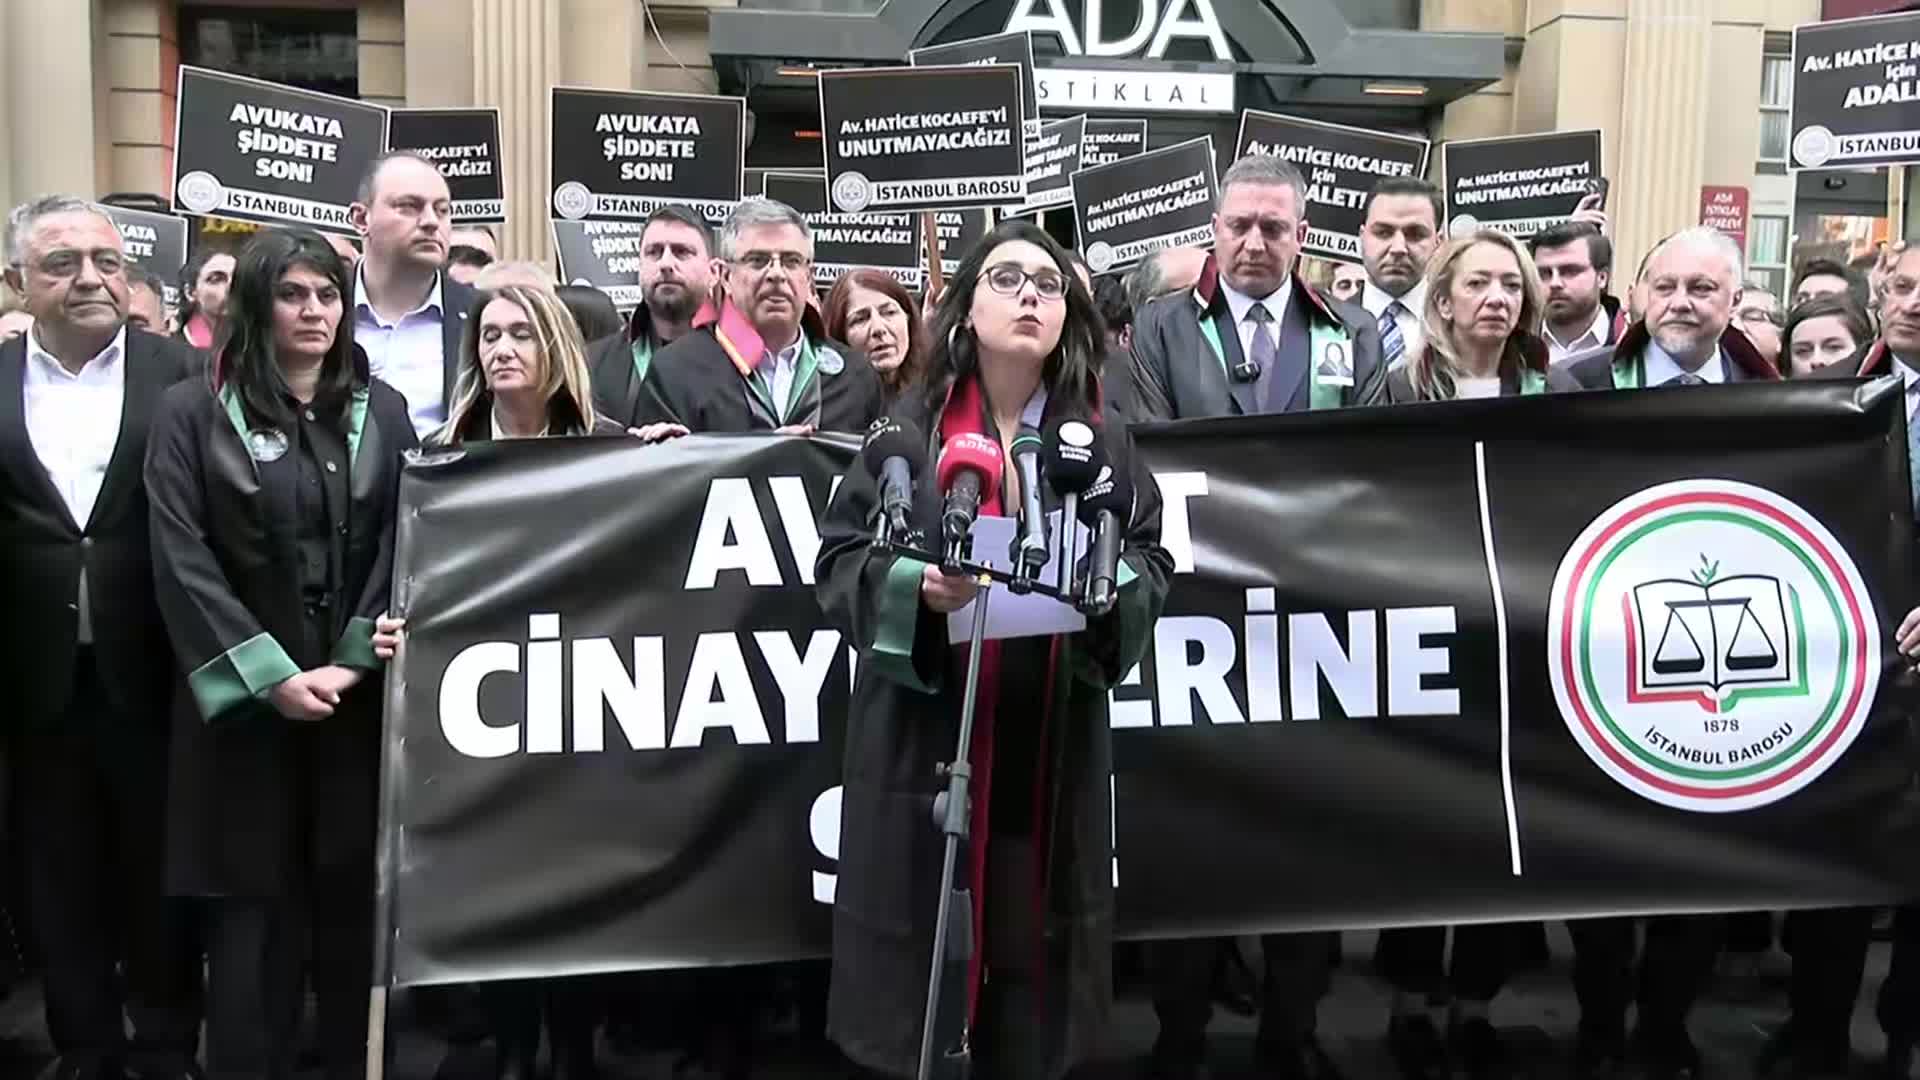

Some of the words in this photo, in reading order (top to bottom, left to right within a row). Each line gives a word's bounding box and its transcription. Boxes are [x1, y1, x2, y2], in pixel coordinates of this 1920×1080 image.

[1001, 0, 1237, 61] ADA
[1801, 55, 1832, 73] Av.
[1834, 42, 1909, 69] HATİCE
[1885, 62, 1917, 82] için
[1038, 76, 1209, 105] STİKLAL
[1842, 80, 1920, 109] ADAL
[229, 102, 344, 139] AVUKATA
[595, 113, 701, 135] AVUKATA
[840, 119, 863, 135] Av.
[864, 113, 919, 132] HATİCE
[921, 106, 1008, 128] KOCAEFE'Yİ
[237, 128, 338, 163] ŞİDDETE
[603, 134, 696, 161] ŞİDDETE
[838, 127, 1012, 158] UNUTMAYACAĞIZI
[255, 157, 314, 184] SON!
[620, 162, 674, 181] SON!
[1273, 144, 1333, 167] HATİCE
[1333, 152, 1414, 178] KOCAEFE
[227, 190, 309, 219] İSTANBUL
[876, 183, 954, 200] İSTANBUL
[957, 180, 1021, 197] BAROSU
[1302, 183, 1368, 210] ALET!
[1086, 186, 1210, 233] UNUTMAYACAĞIZI
[1174, 228, 1213, 247] BAROS
[1703, 719, 1740, 733] 1878
[1644, 724, 1723, 765] İSTANBUL
[1728, 722, 1794, 763] BAROSU
